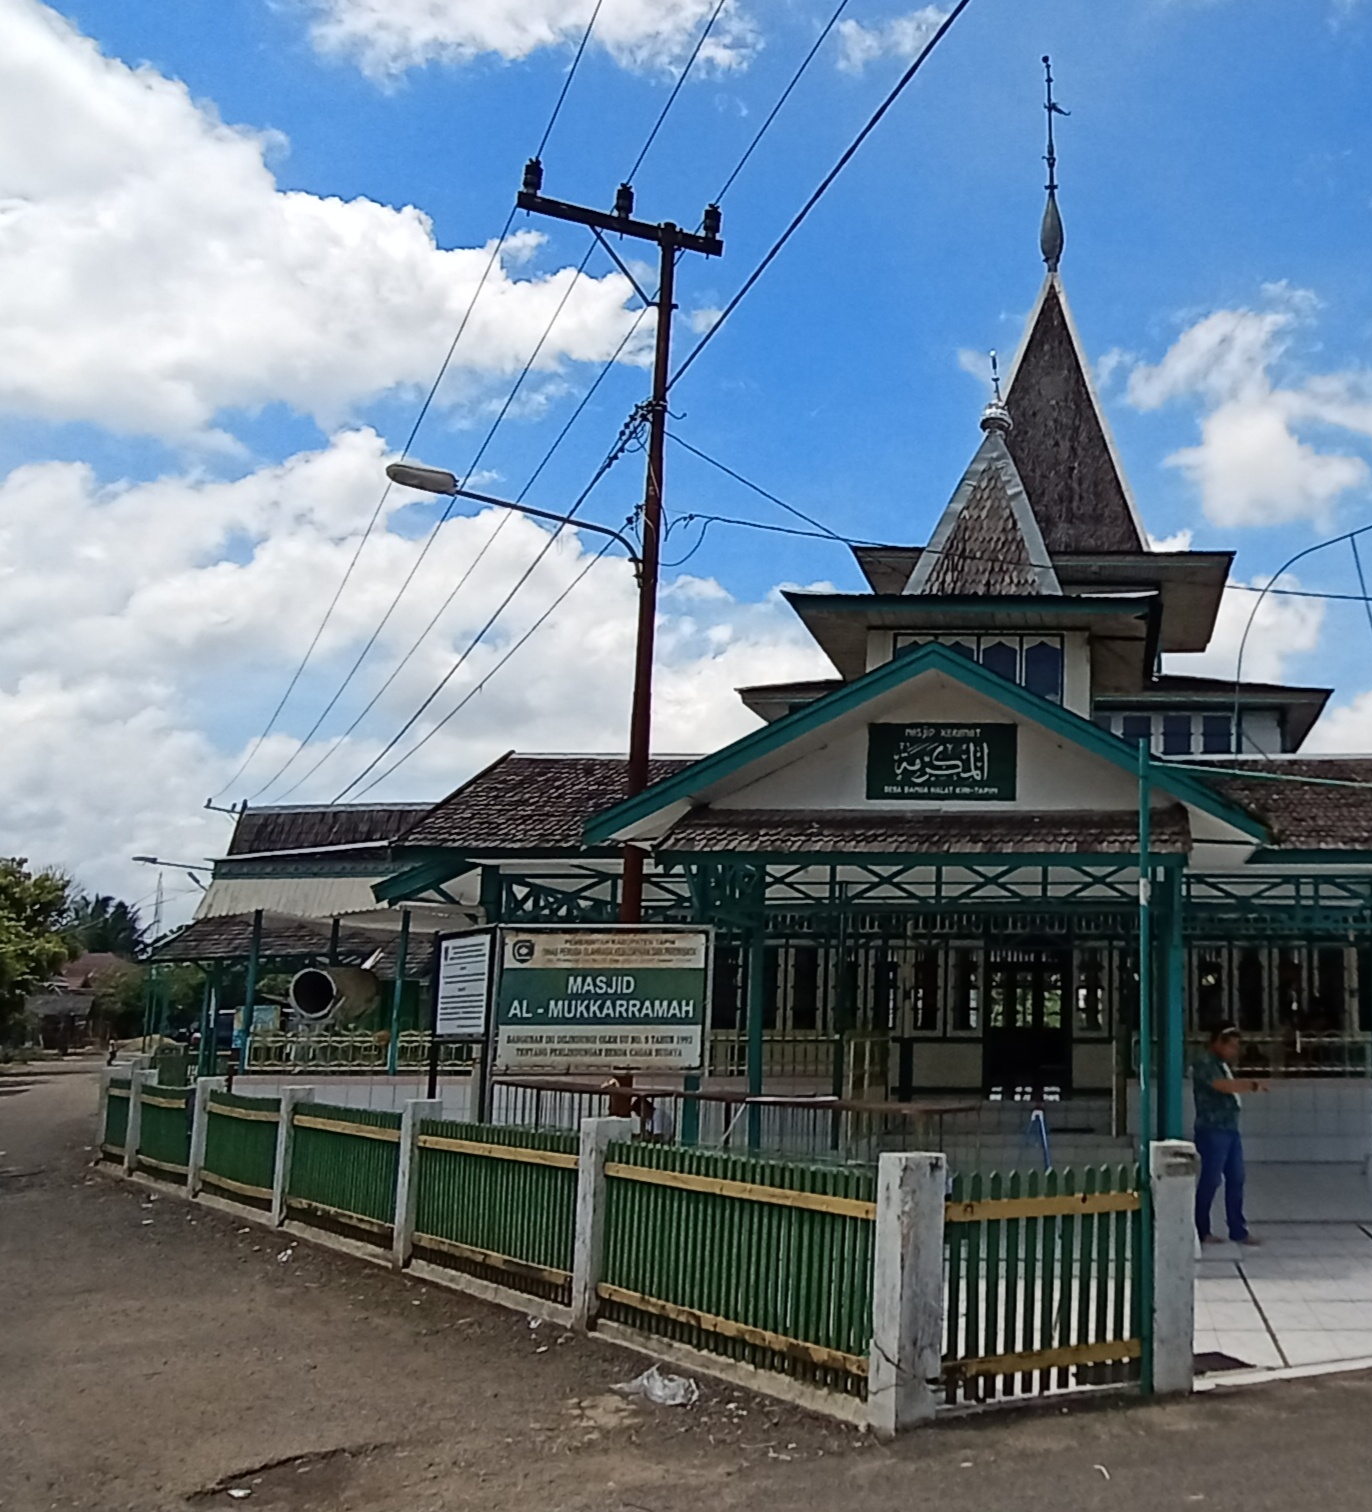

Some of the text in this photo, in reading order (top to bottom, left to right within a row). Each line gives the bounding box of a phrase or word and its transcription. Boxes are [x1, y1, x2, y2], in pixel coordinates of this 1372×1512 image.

[884, 785, 902, 794] DESA
[567, 976, 635, 995] MASJID
[508, 999, 533, 1018] AL
[548, 999, 695, 1018] MUKKARRAMAH
